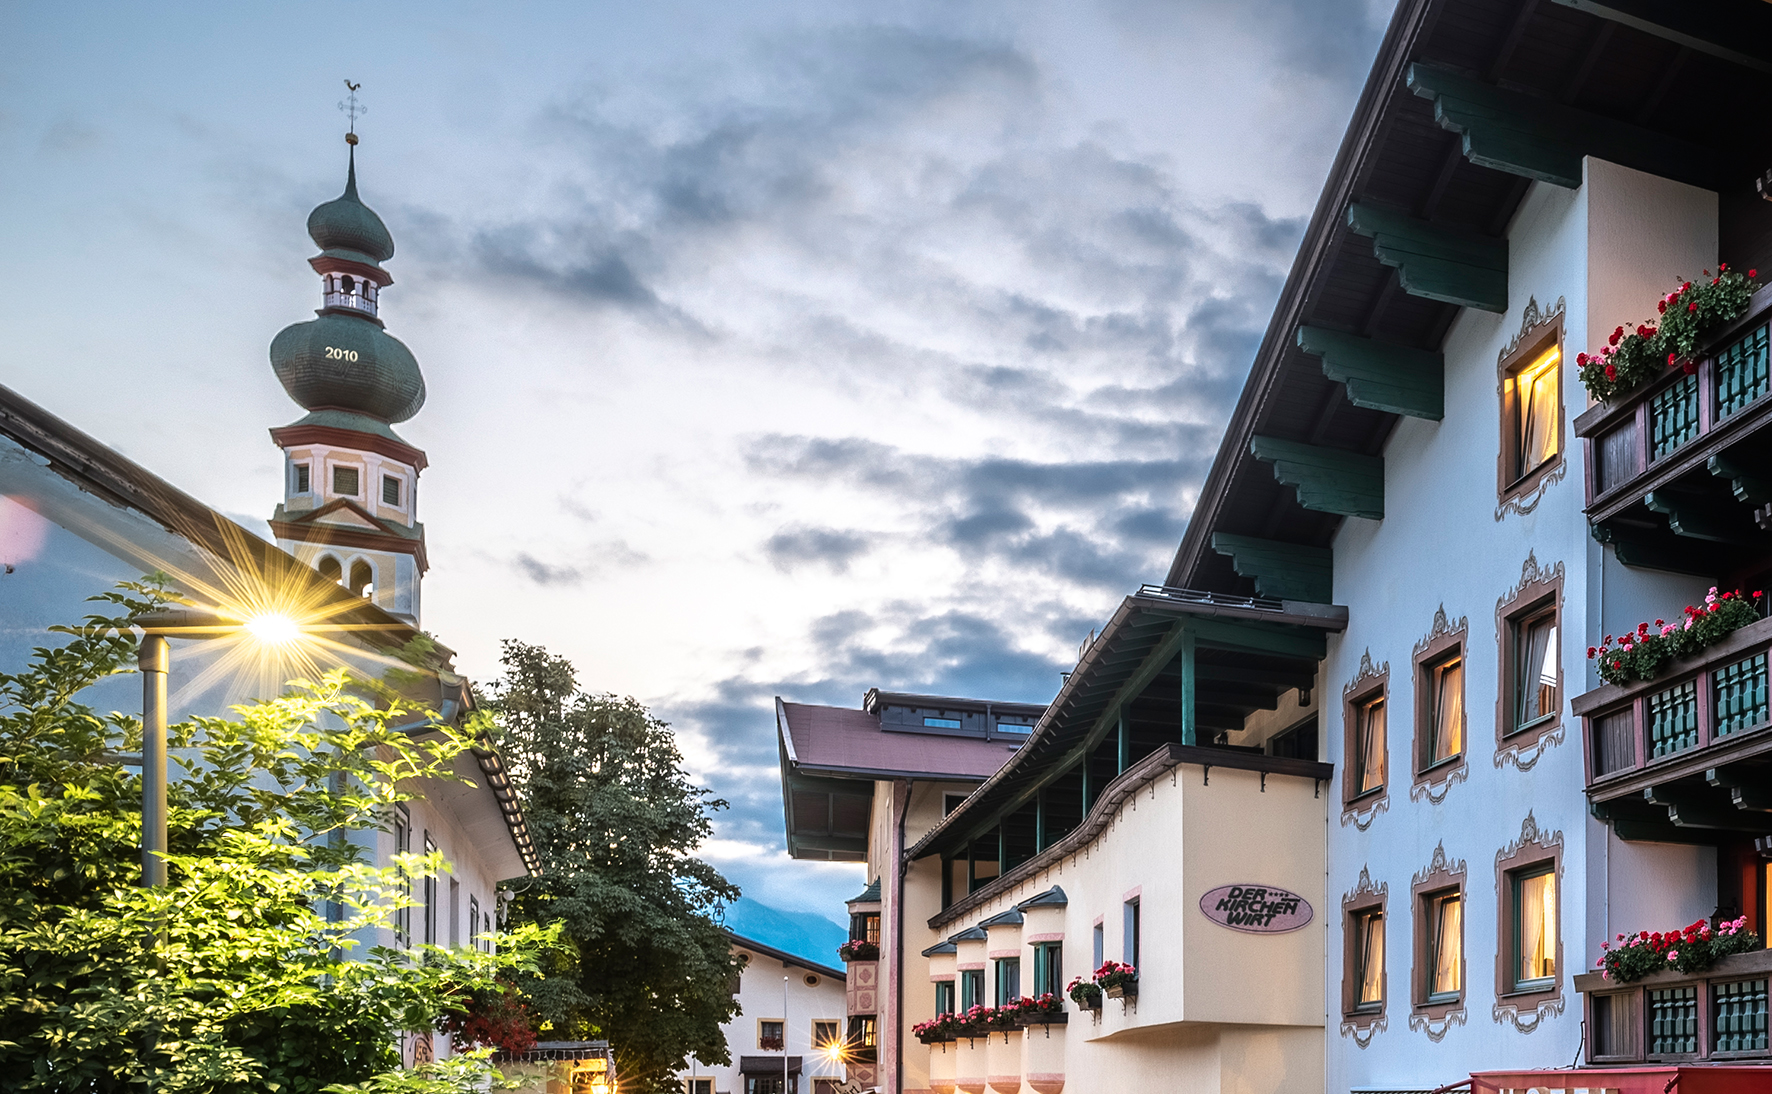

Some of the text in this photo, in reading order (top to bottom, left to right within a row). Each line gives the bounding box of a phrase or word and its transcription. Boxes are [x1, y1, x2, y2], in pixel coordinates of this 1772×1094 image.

[325, 346, 358, 362] 2010
[1228, 887, 1267, 900] DER
[1215, 898, 1298, 915] KIRCHEN
[1226, 911, 1276, 927] WIRT
